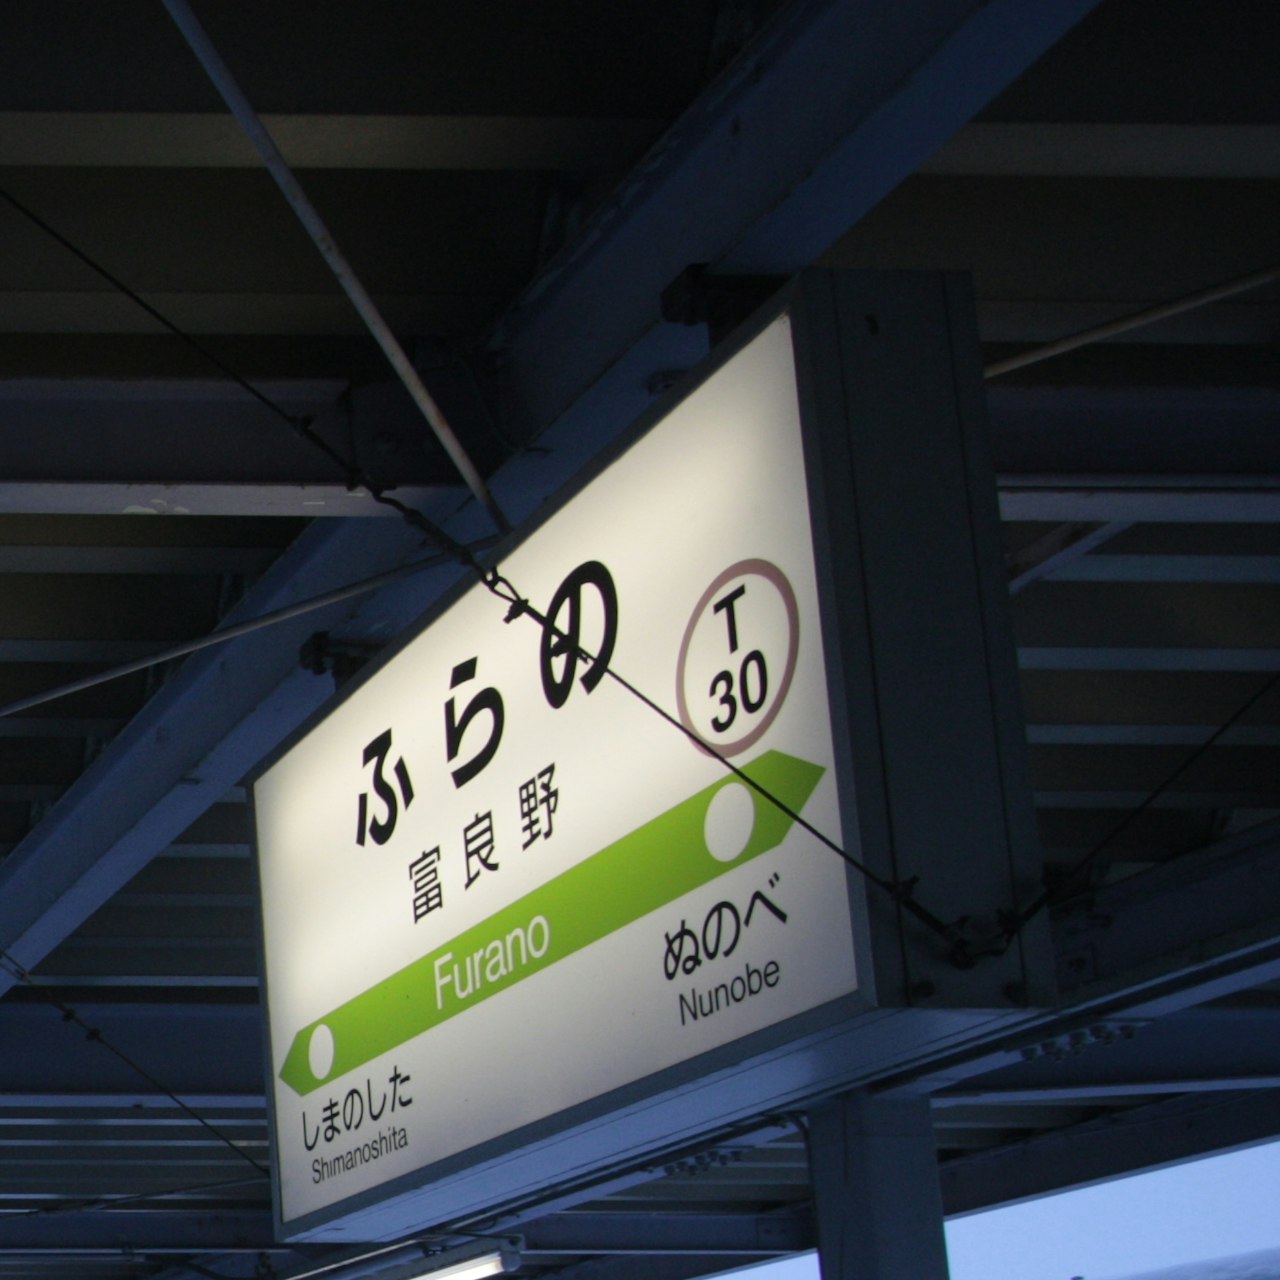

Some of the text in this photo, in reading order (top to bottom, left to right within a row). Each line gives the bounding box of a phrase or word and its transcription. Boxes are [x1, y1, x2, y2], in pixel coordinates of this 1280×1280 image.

[713, 584, 746, 654] T
[356, 561, 618, 846] ふらの
[709, 649, 768, 733] 30
[408, 763, 558, 923] 富良野
[434, 915, 550, 1010] Furano
[663, 872, 788, 981] ぬのべ
[679, 960, 780, 1026] Nunobe
[302, 1065, 413, 1152] しまのした
[312, 1126, 409, 1184] Shimanoshita
